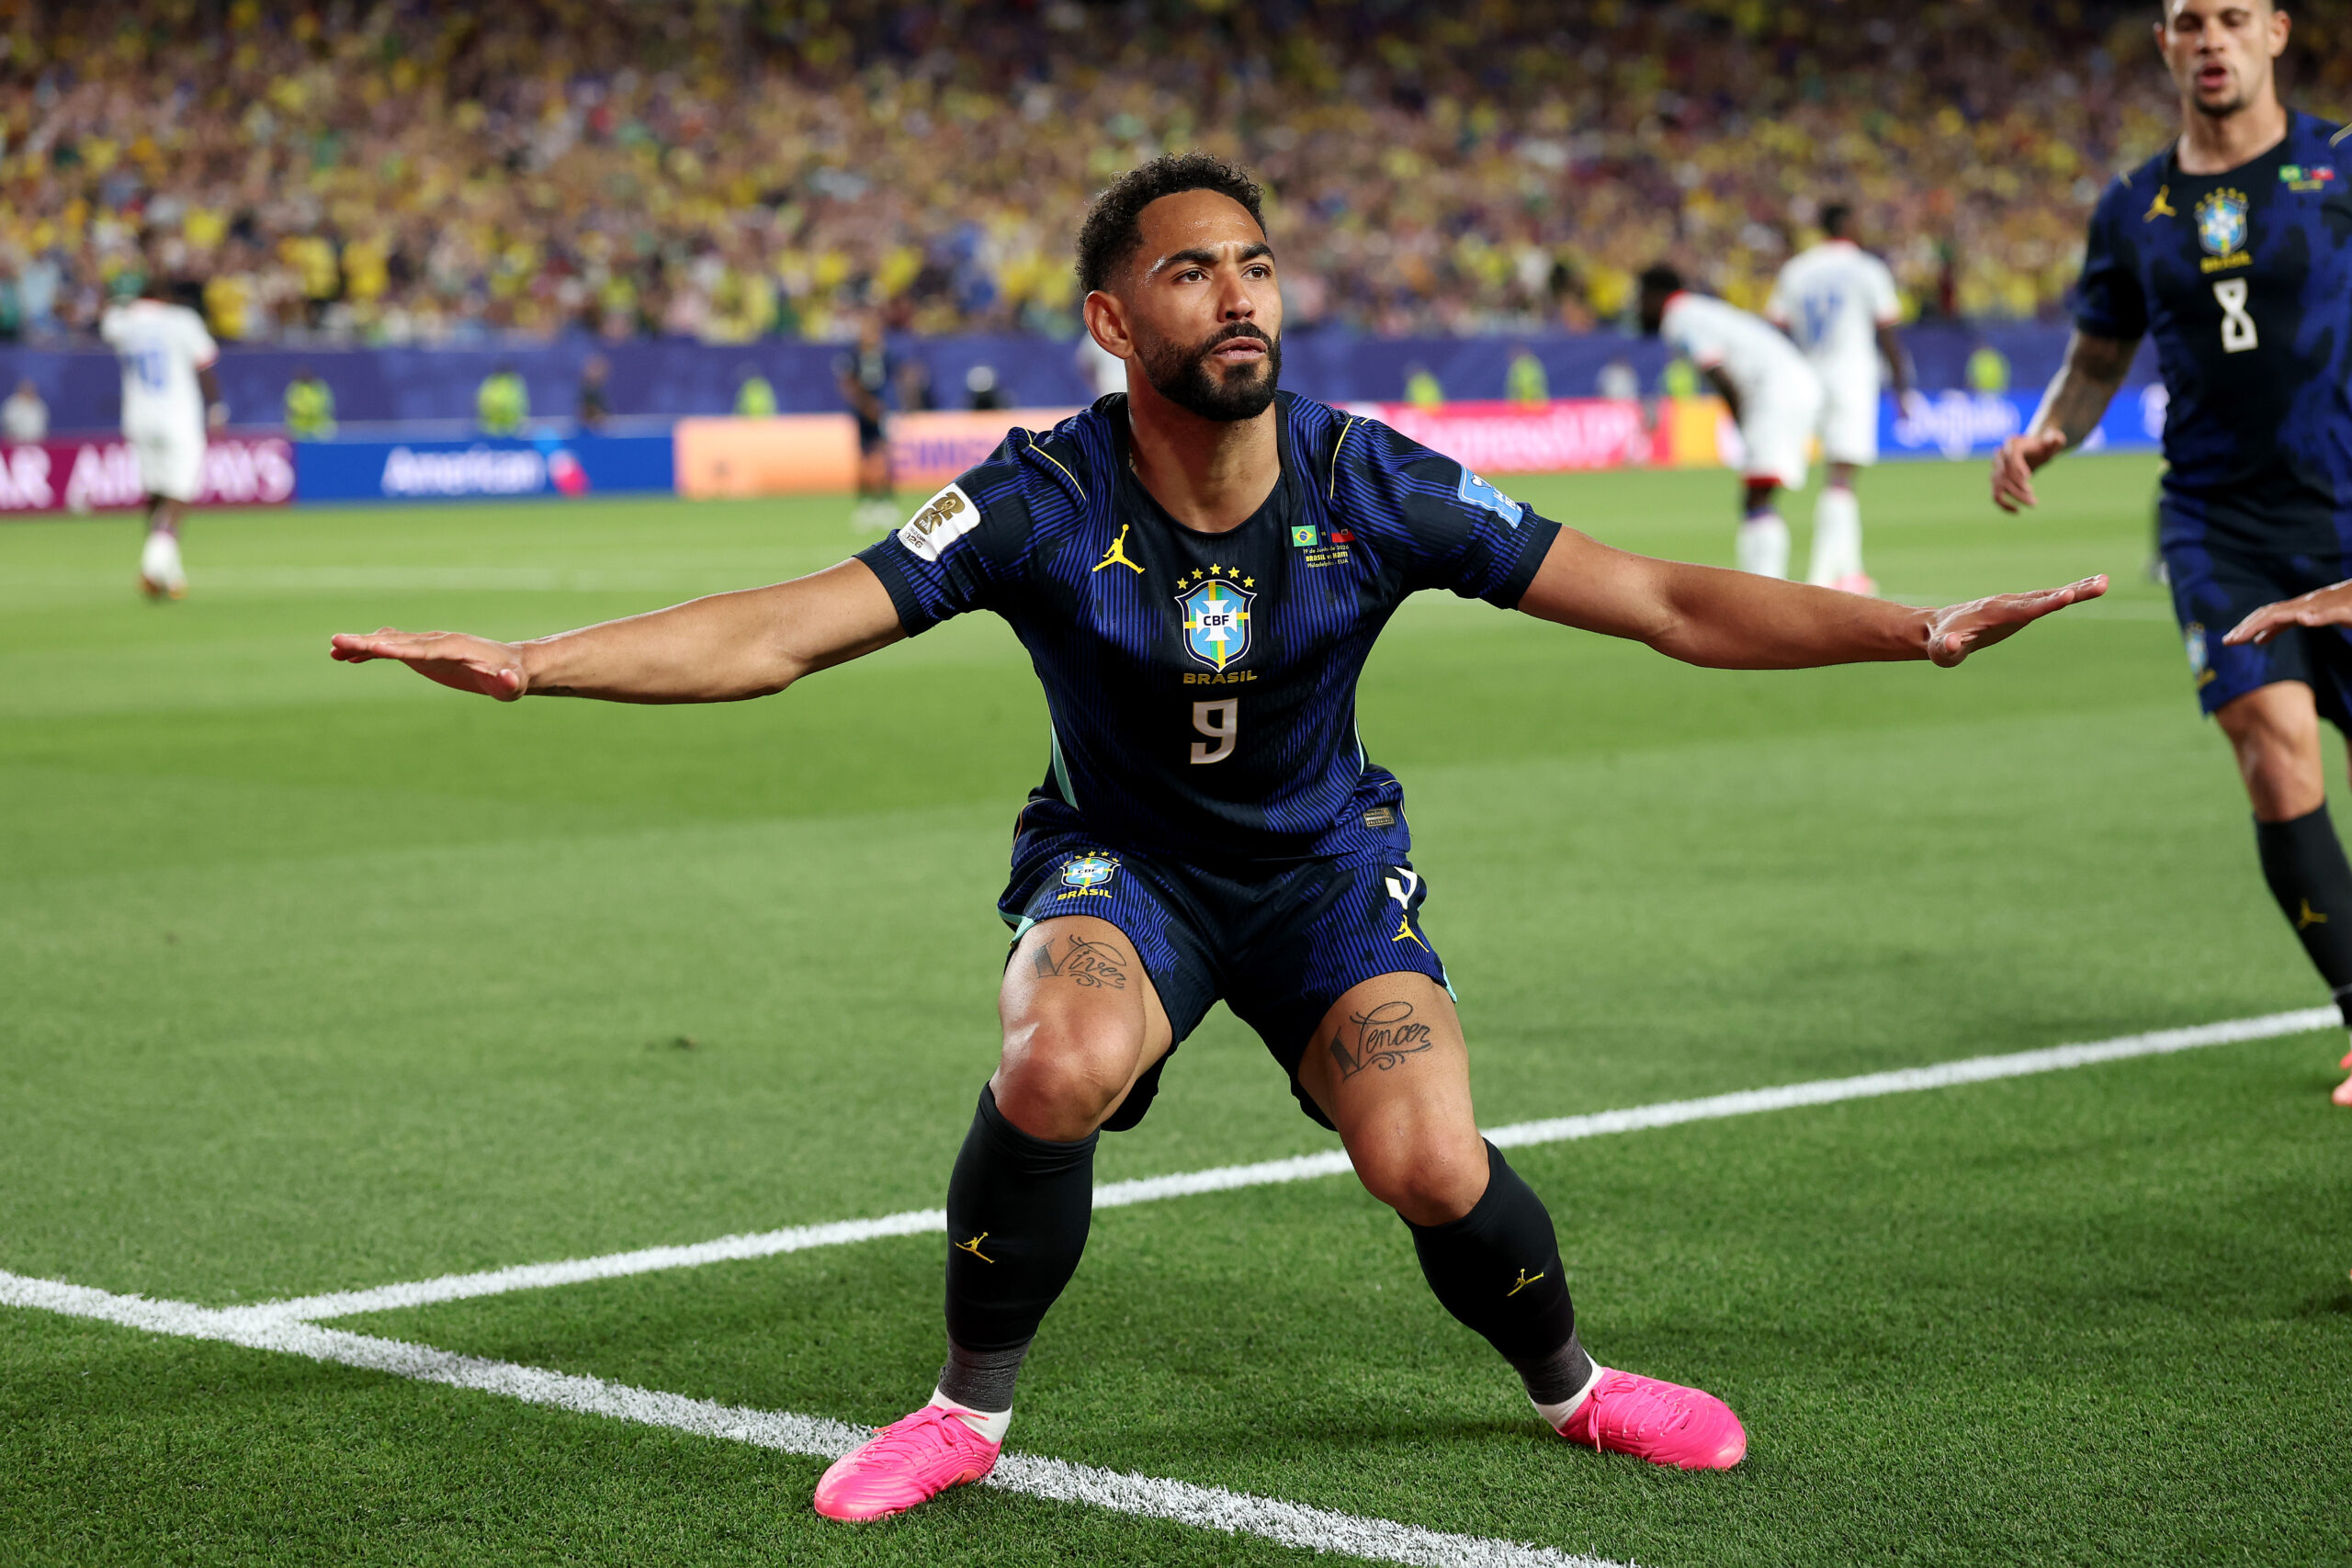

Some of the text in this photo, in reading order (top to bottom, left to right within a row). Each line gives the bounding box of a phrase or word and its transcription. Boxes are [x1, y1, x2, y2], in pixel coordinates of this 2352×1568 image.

[2212, 277, 2258, 354] 8
[1203, 615, 1230, 626] CBF
[1182, 671, 1258, 684] BRASIL
[1190, 697, 1238, 765] 9
[1057, 888, 1113, 900] BRASIL
